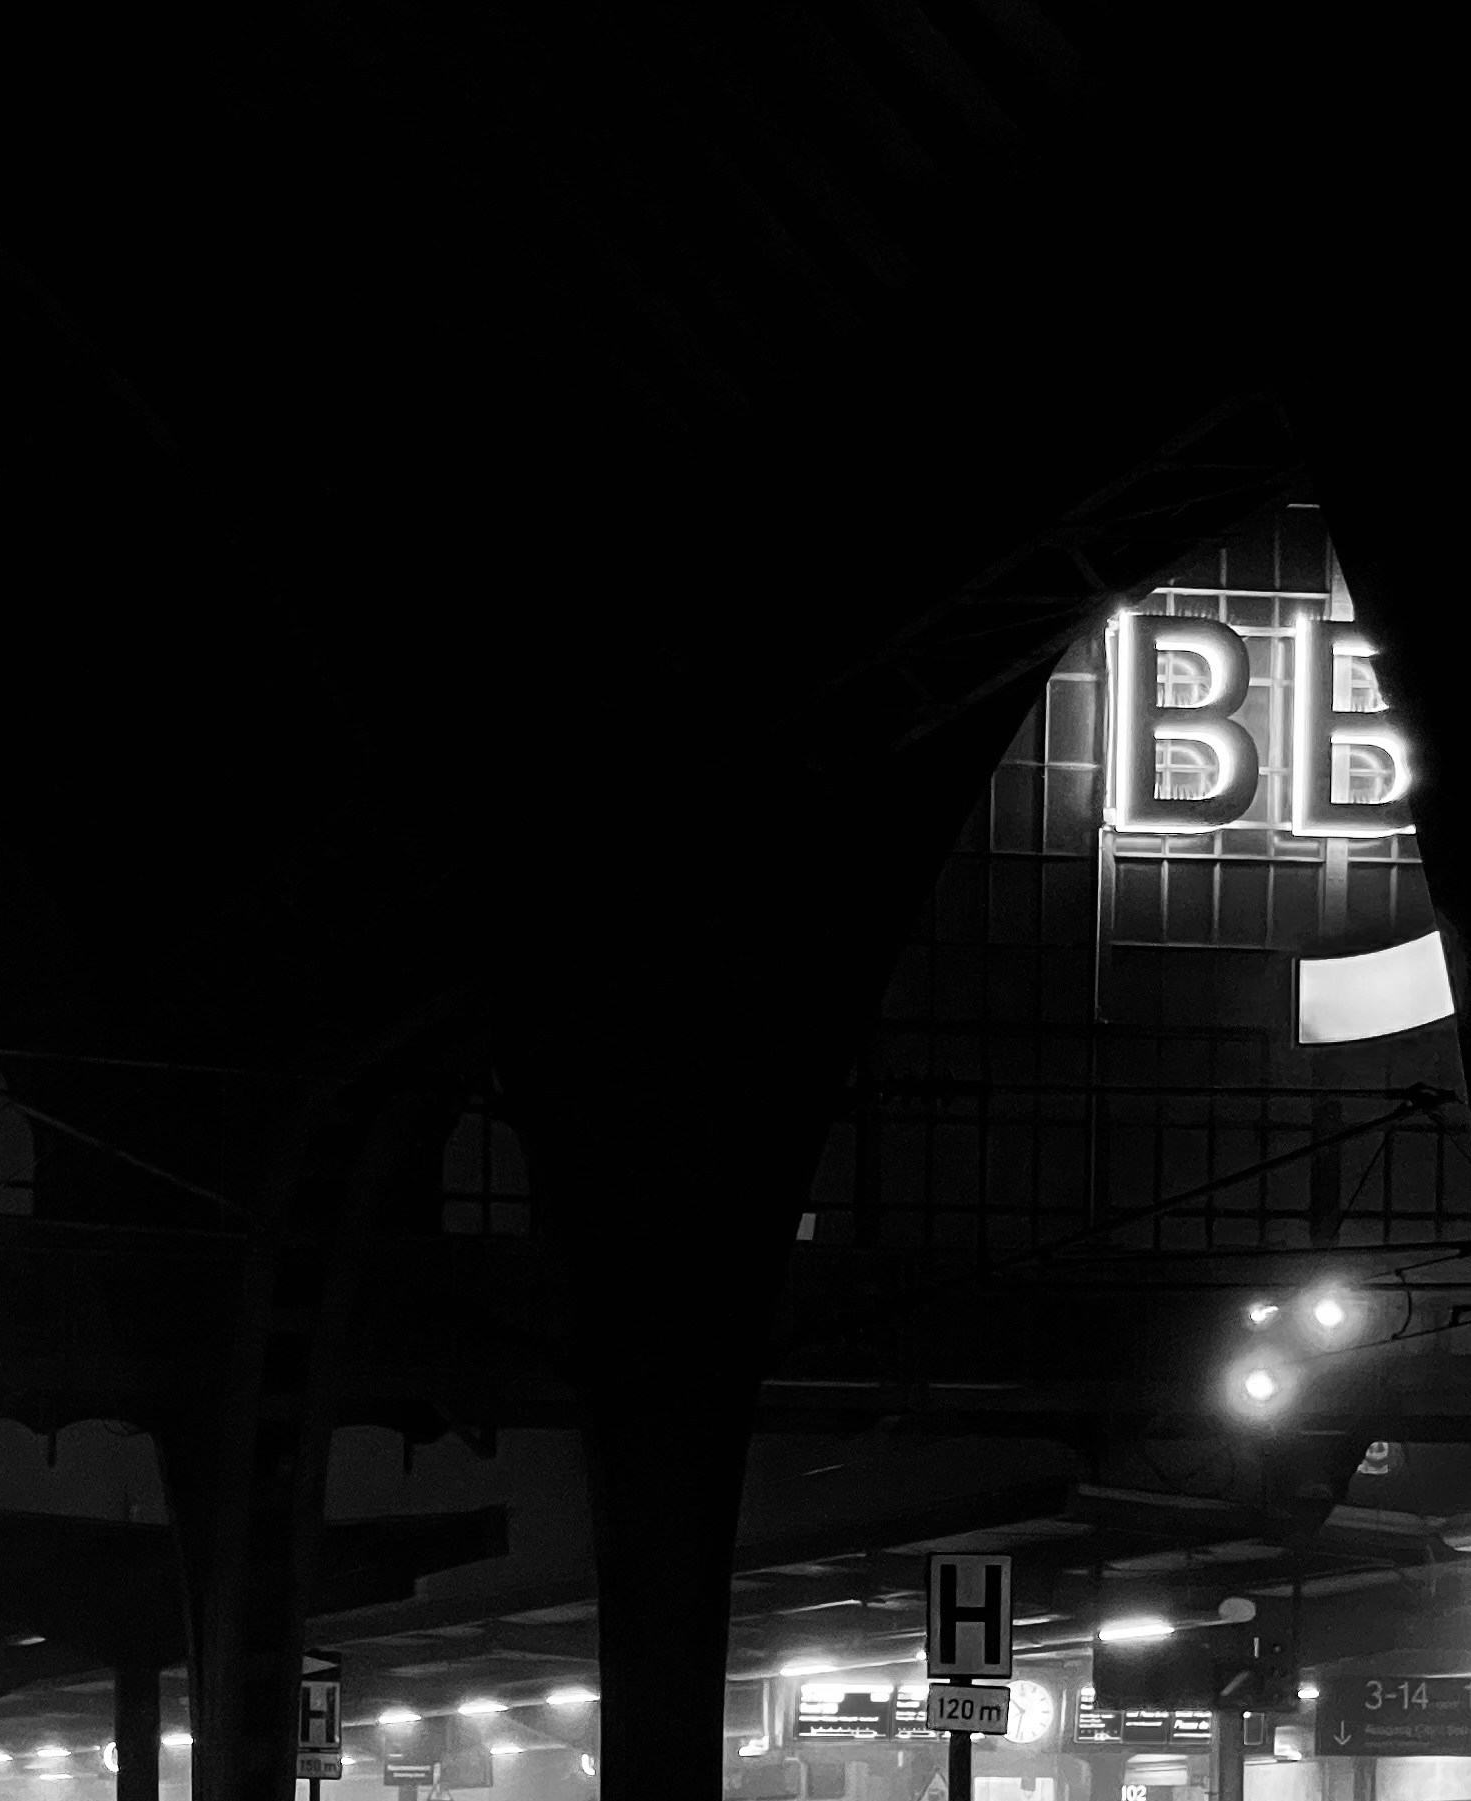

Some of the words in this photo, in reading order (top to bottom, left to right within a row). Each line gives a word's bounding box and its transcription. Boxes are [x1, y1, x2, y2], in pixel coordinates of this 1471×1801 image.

[940, 1564, 1001, 1665] H
[938, 1698, 974, 1720] 120
[979, 1705, 1001, 1722] m
[1365, 1680, 1428, 1710] 3-14
[300, 1685, 336, 1743] H
[1121, 1785, 1147, 1801] 102
